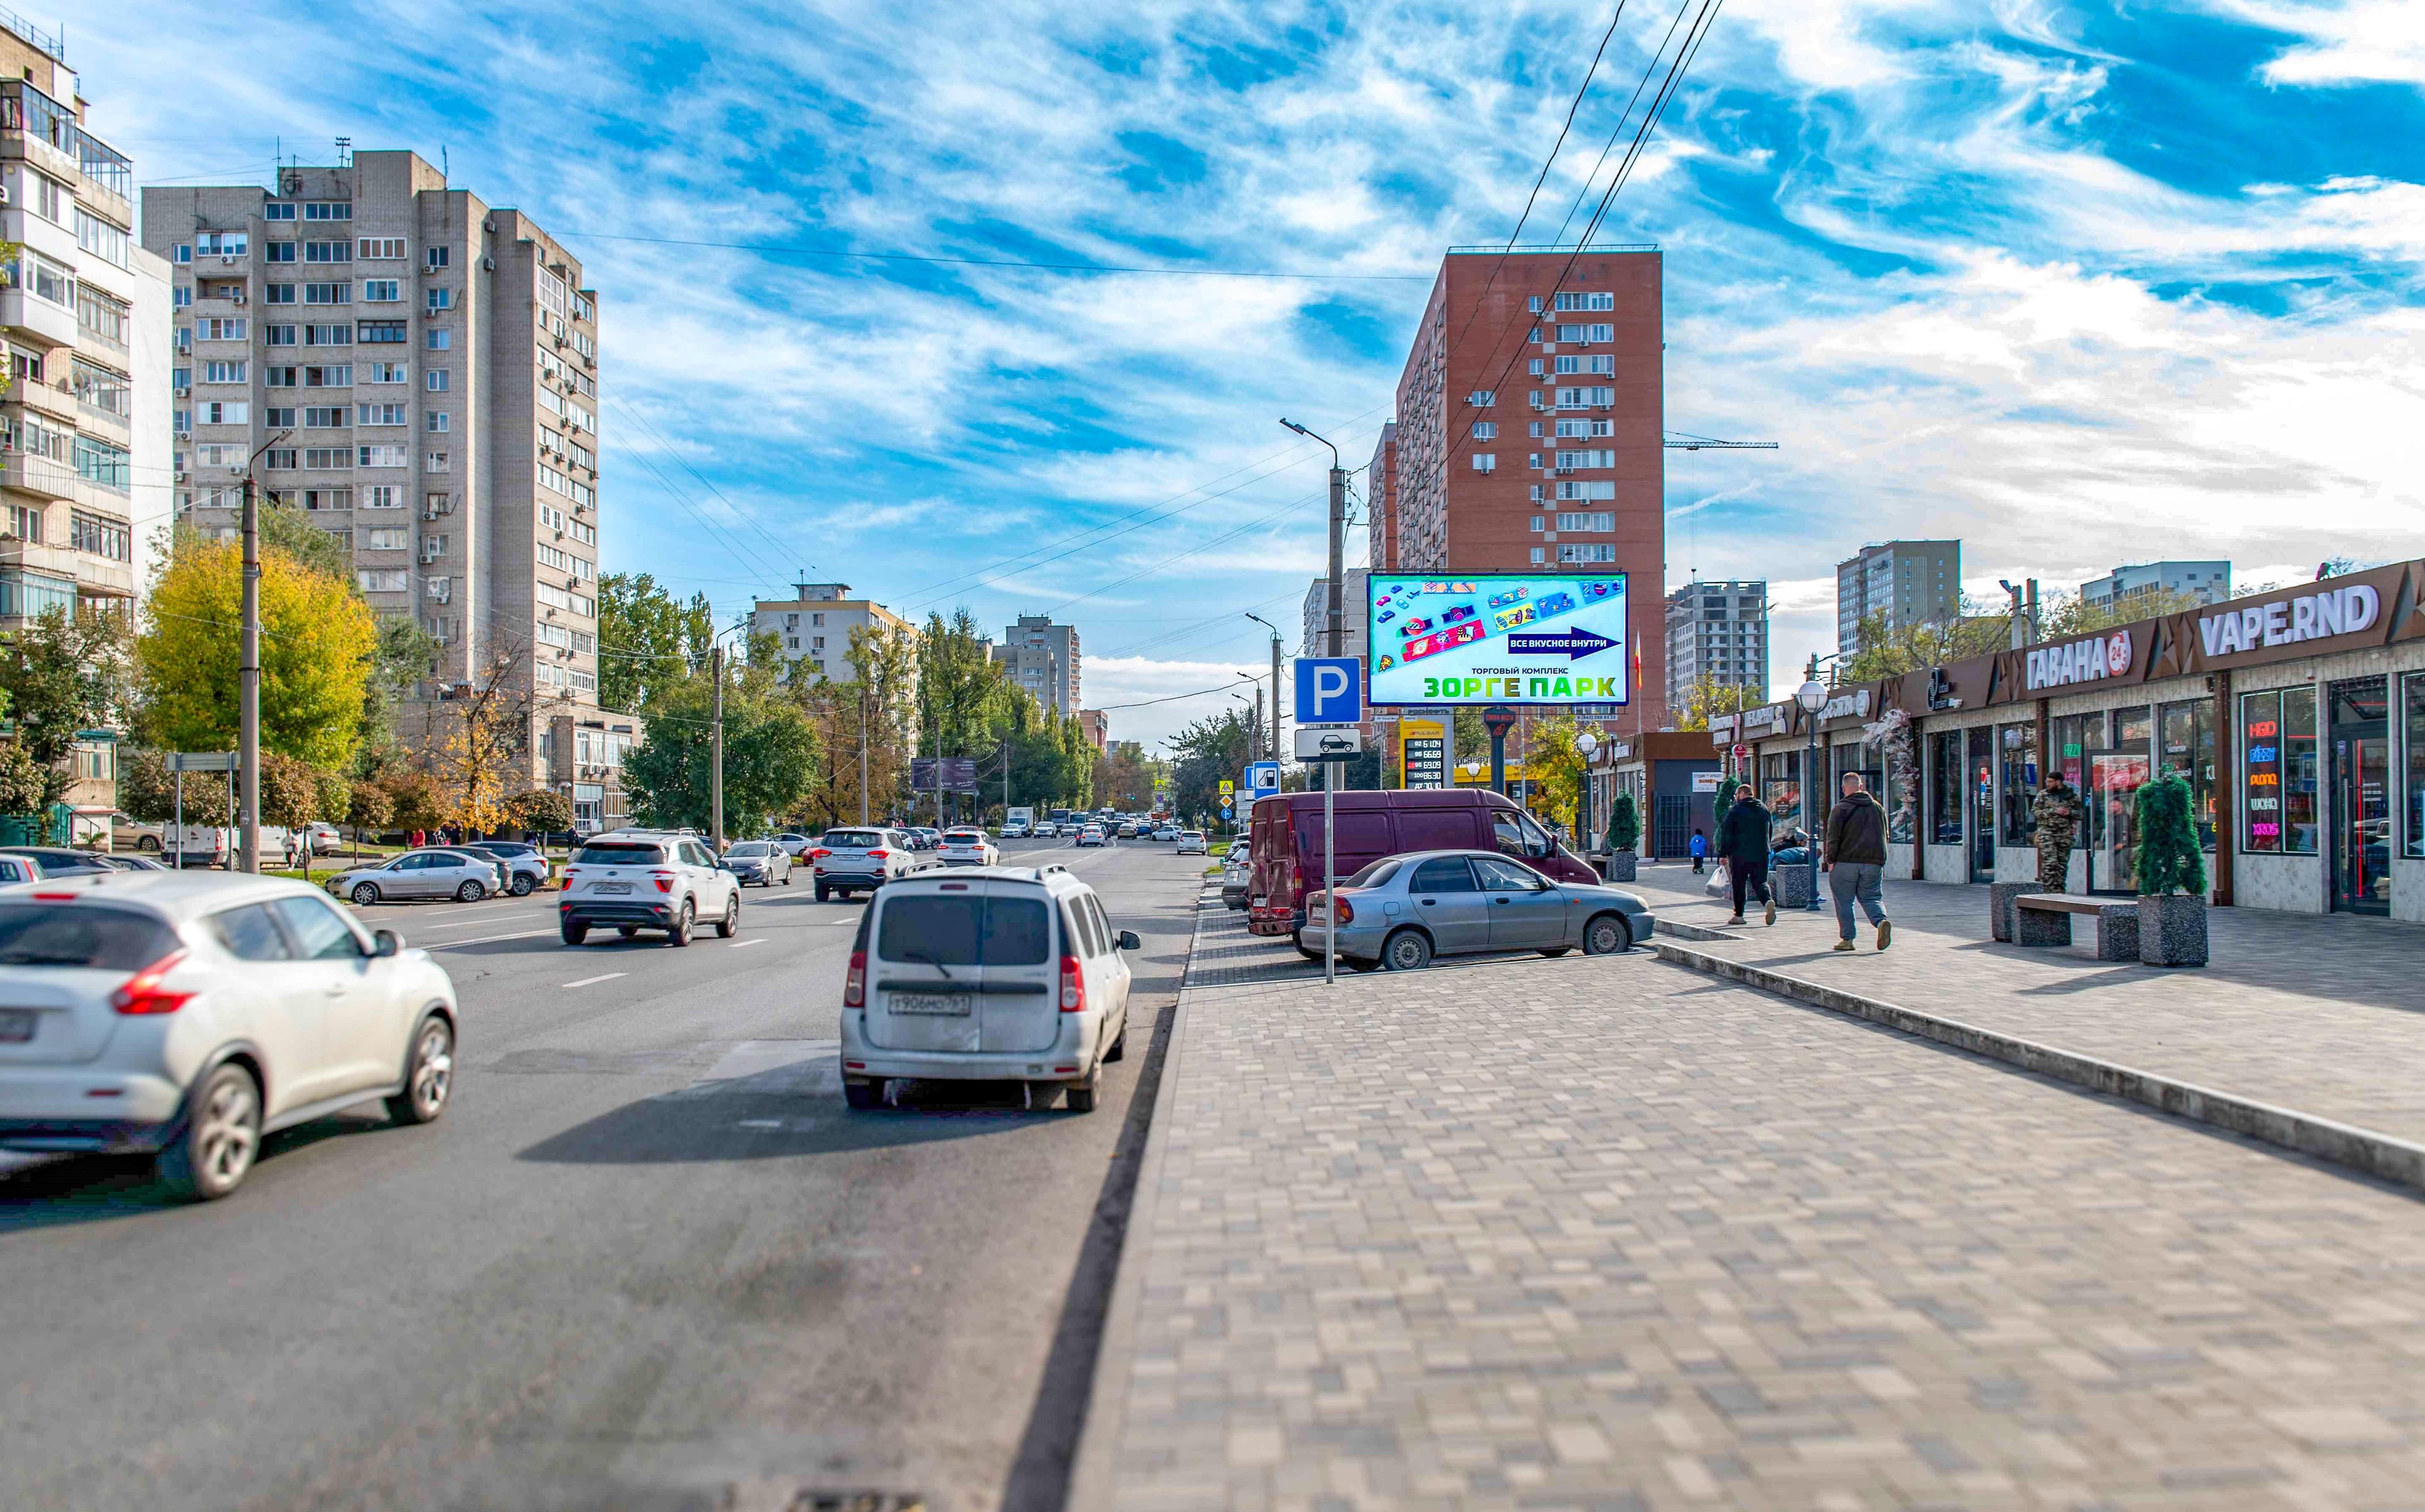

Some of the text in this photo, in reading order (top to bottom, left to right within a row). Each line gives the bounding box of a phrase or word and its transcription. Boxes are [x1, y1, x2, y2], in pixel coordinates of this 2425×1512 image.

[2198, 585, 2380, 657] VAPE.RND
[1510, 639, 1607, 648] ВСЕ ВКУСНОЕ ВНУТРИ
[1471, 667, 1519, 675] ТОРГОВЫЙ
[2027, 636, 2123, 691] ГАВАНА 24
[1314, 666, 1348, 716] P
[1423, 677, 1616, 698] ЗОРГЕ ПАРК
[2249, 721, 2276, 737] HQD
[1452, 756, 1491, 766] РОСНЕФТ
